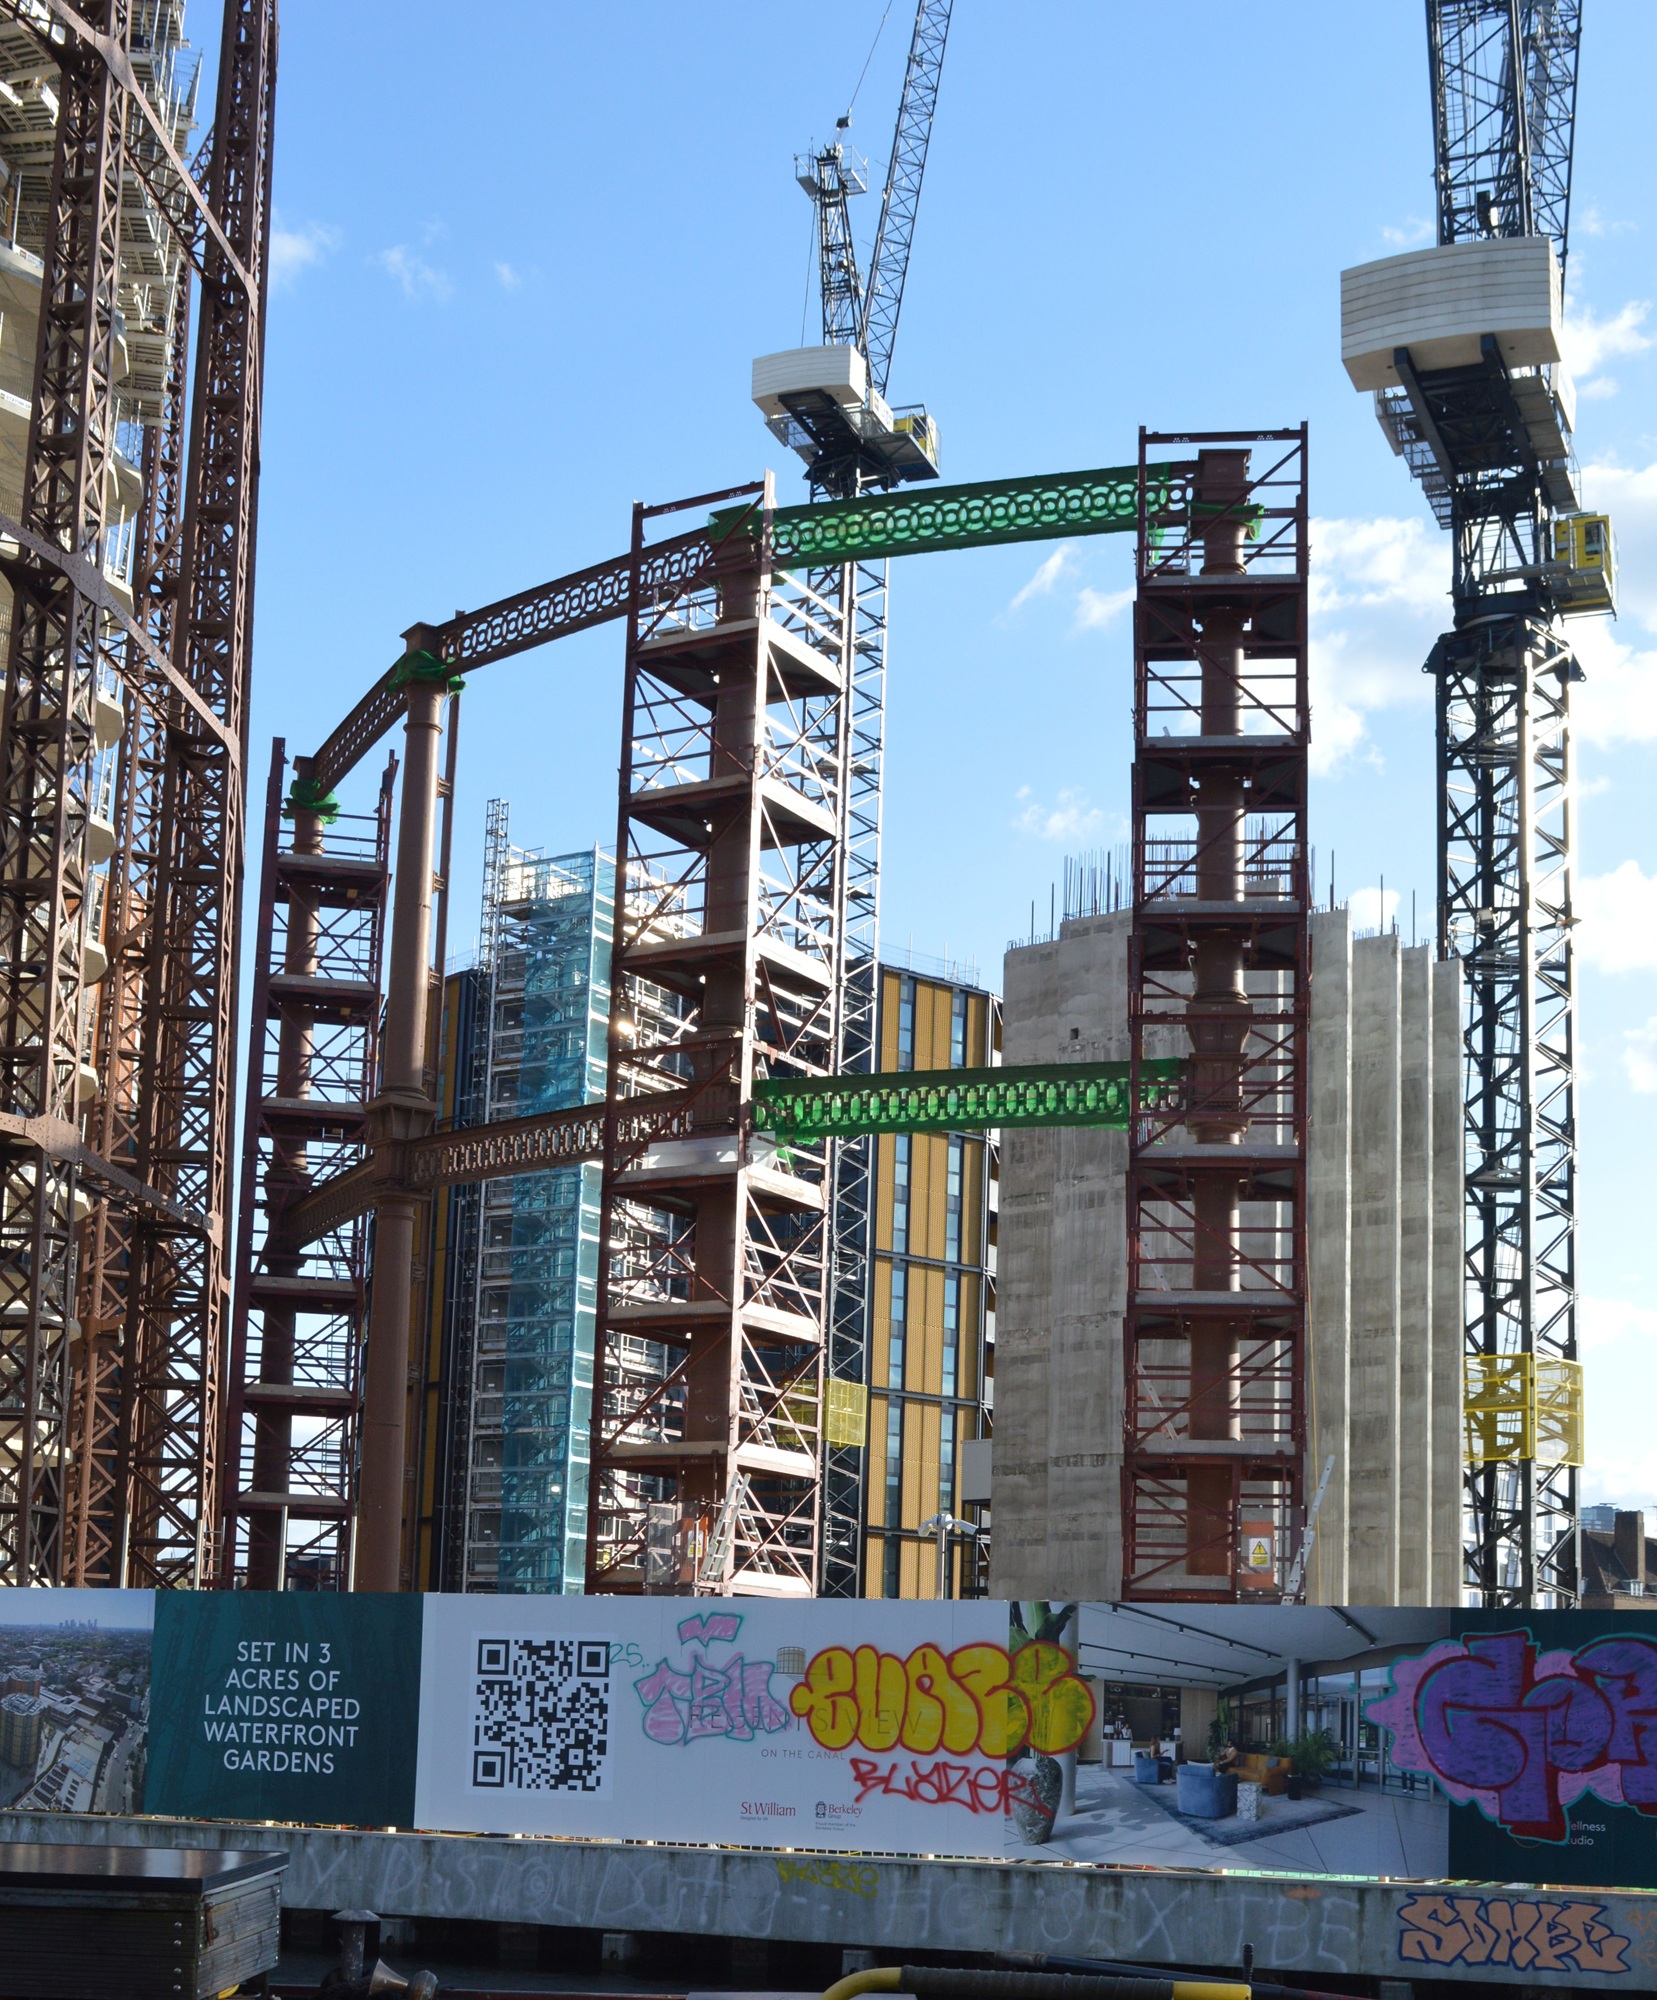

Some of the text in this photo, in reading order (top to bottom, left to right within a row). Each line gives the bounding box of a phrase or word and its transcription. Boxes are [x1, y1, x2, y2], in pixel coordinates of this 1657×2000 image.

[237, 1641, 331, 1664] SET IN 3
[225, 1668, 341, 1691] ACRES OF
[204, 1694, 360, 1720] LANDSCAPED
[204, 1721, 359, 1747] WATERFRONT
[223, 1749, 335, 1774] GARDENS
[761, 1748, 846, 1760] ON THE CANAL
[740, 1801, 796, 1817] St William
[828, 1804, 863, 1817] Berkeley
[1569, 1820, 1606, 1832] ellness
[1569, 1835, 1594, 1846] udio
